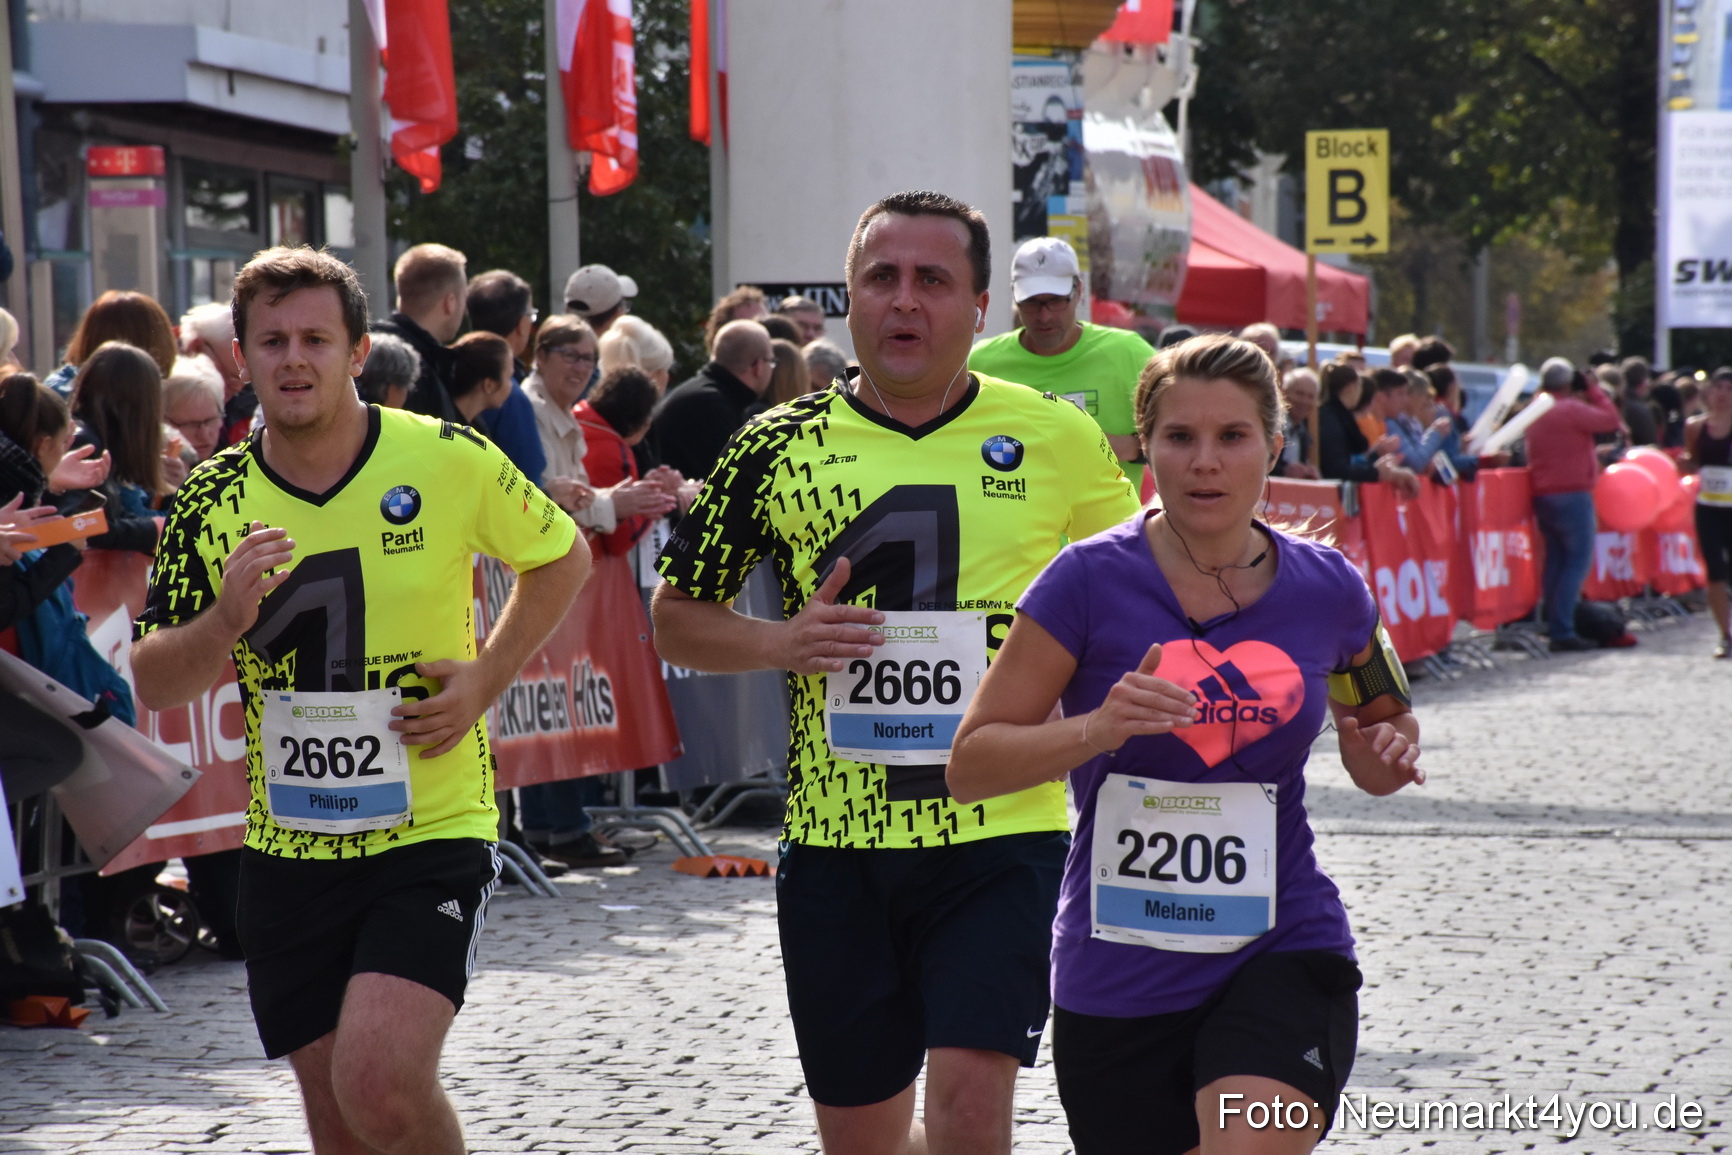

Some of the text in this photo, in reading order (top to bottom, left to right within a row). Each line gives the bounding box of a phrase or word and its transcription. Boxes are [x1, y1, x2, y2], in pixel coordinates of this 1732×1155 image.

[1316, 135, 1379, 158] Block
[1328, 168, 1368, 227] B
[984, 436, 1022, 447] BMW
[981, 475, 1026, 493] Partl
[383, 486, 418, 501] BMW
[983, 490, 1027, 502] Neumarkt
[381, 527, 424, 547] Partl
[383, 543, 425, 556] Neumarkt
[976, 599, 1002, 609] BMW
[882, 626, 939, 639] BOCK
[383, 652, 408, 664] BMW
[848, 659, 962, 706] 2666
[834, 698, 841, 707] D
[304, 705, 357, 718] BOCK
[1192, 701, 1279, 725] didas
[873, 722, 935, 739] Norbert
[280, 734, 384, 780] 2662
[271, 769, 277, 778] D
[309, 793, 359, 813] Philipp
[1160, 796, 1222, 811] BOCK
[1117, 828, 1247, 885] 2206
[1100, 868, 1108, 878] D
[437, 905, 464, 922] adidas
[1144, 899, 1216, 922] Melanie
